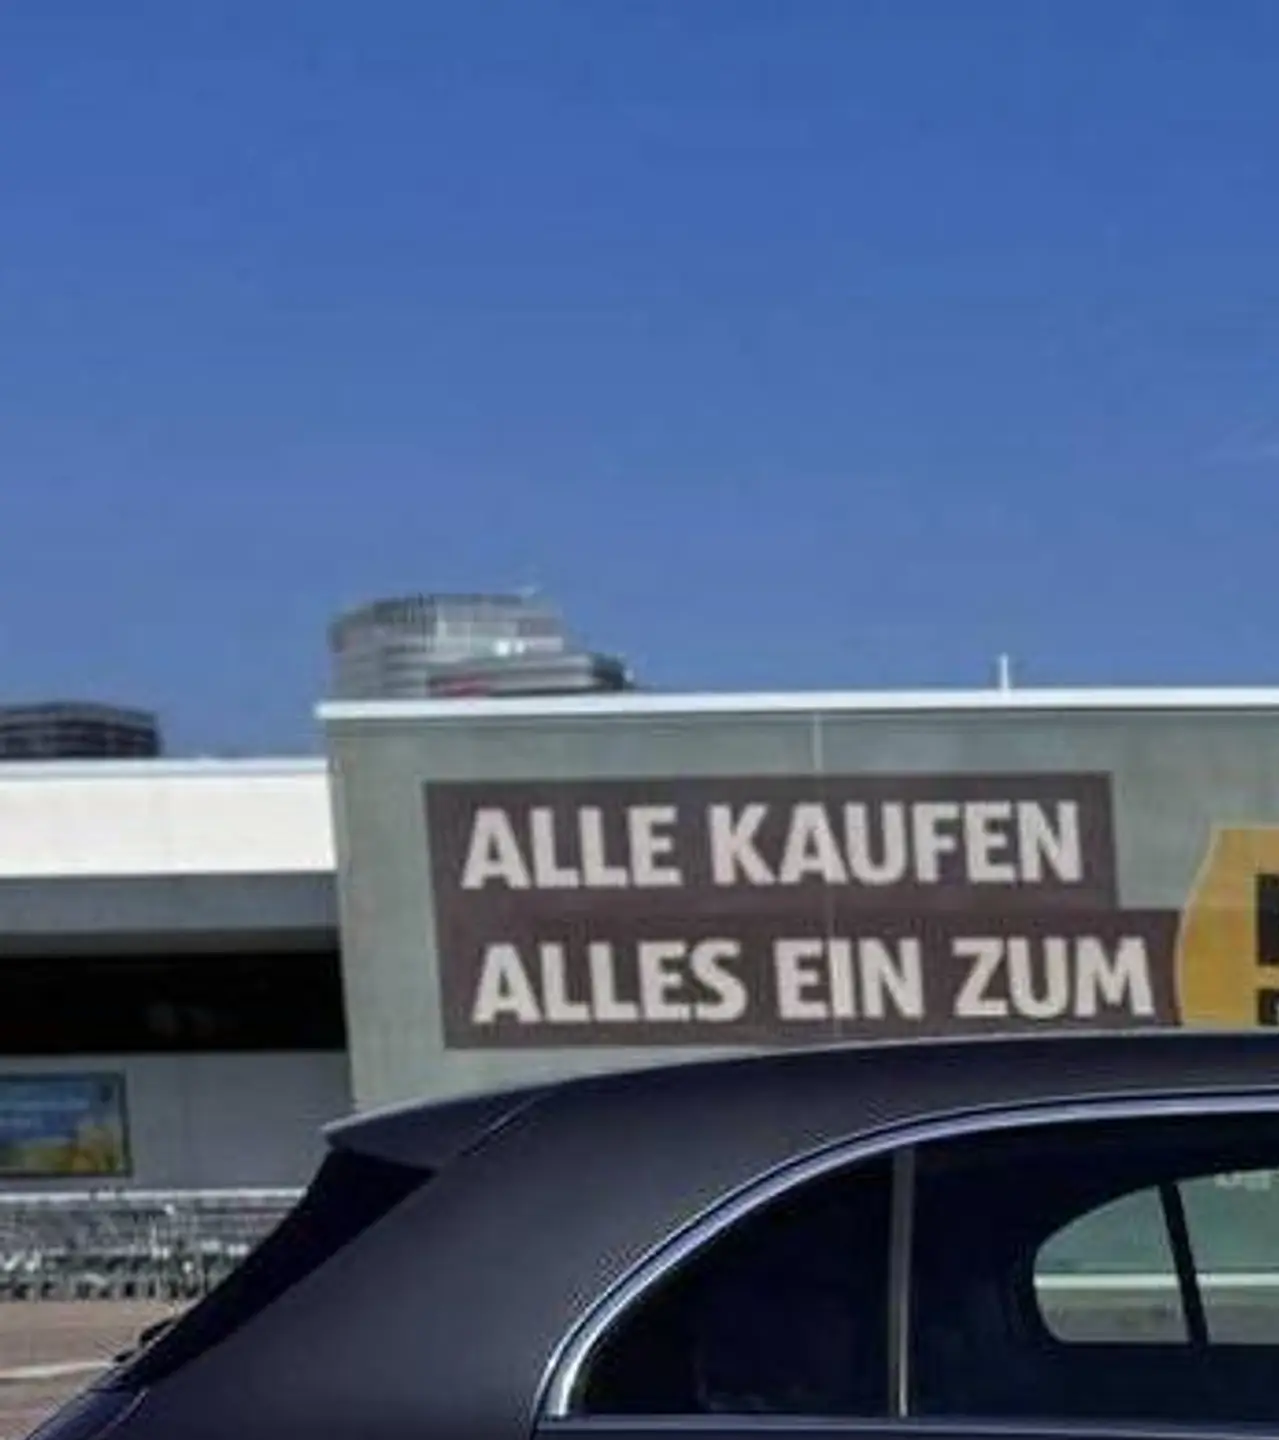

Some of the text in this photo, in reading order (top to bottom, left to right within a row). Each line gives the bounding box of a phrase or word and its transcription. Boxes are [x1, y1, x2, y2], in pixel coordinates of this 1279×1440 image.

[461, 800, 1082, 889] ALLE KAUFEN
[472, 939, 748, 1024] ALLES
[772, 937, 925, 1020] EIN
[951, 934, 1155, 1018] ZUM
